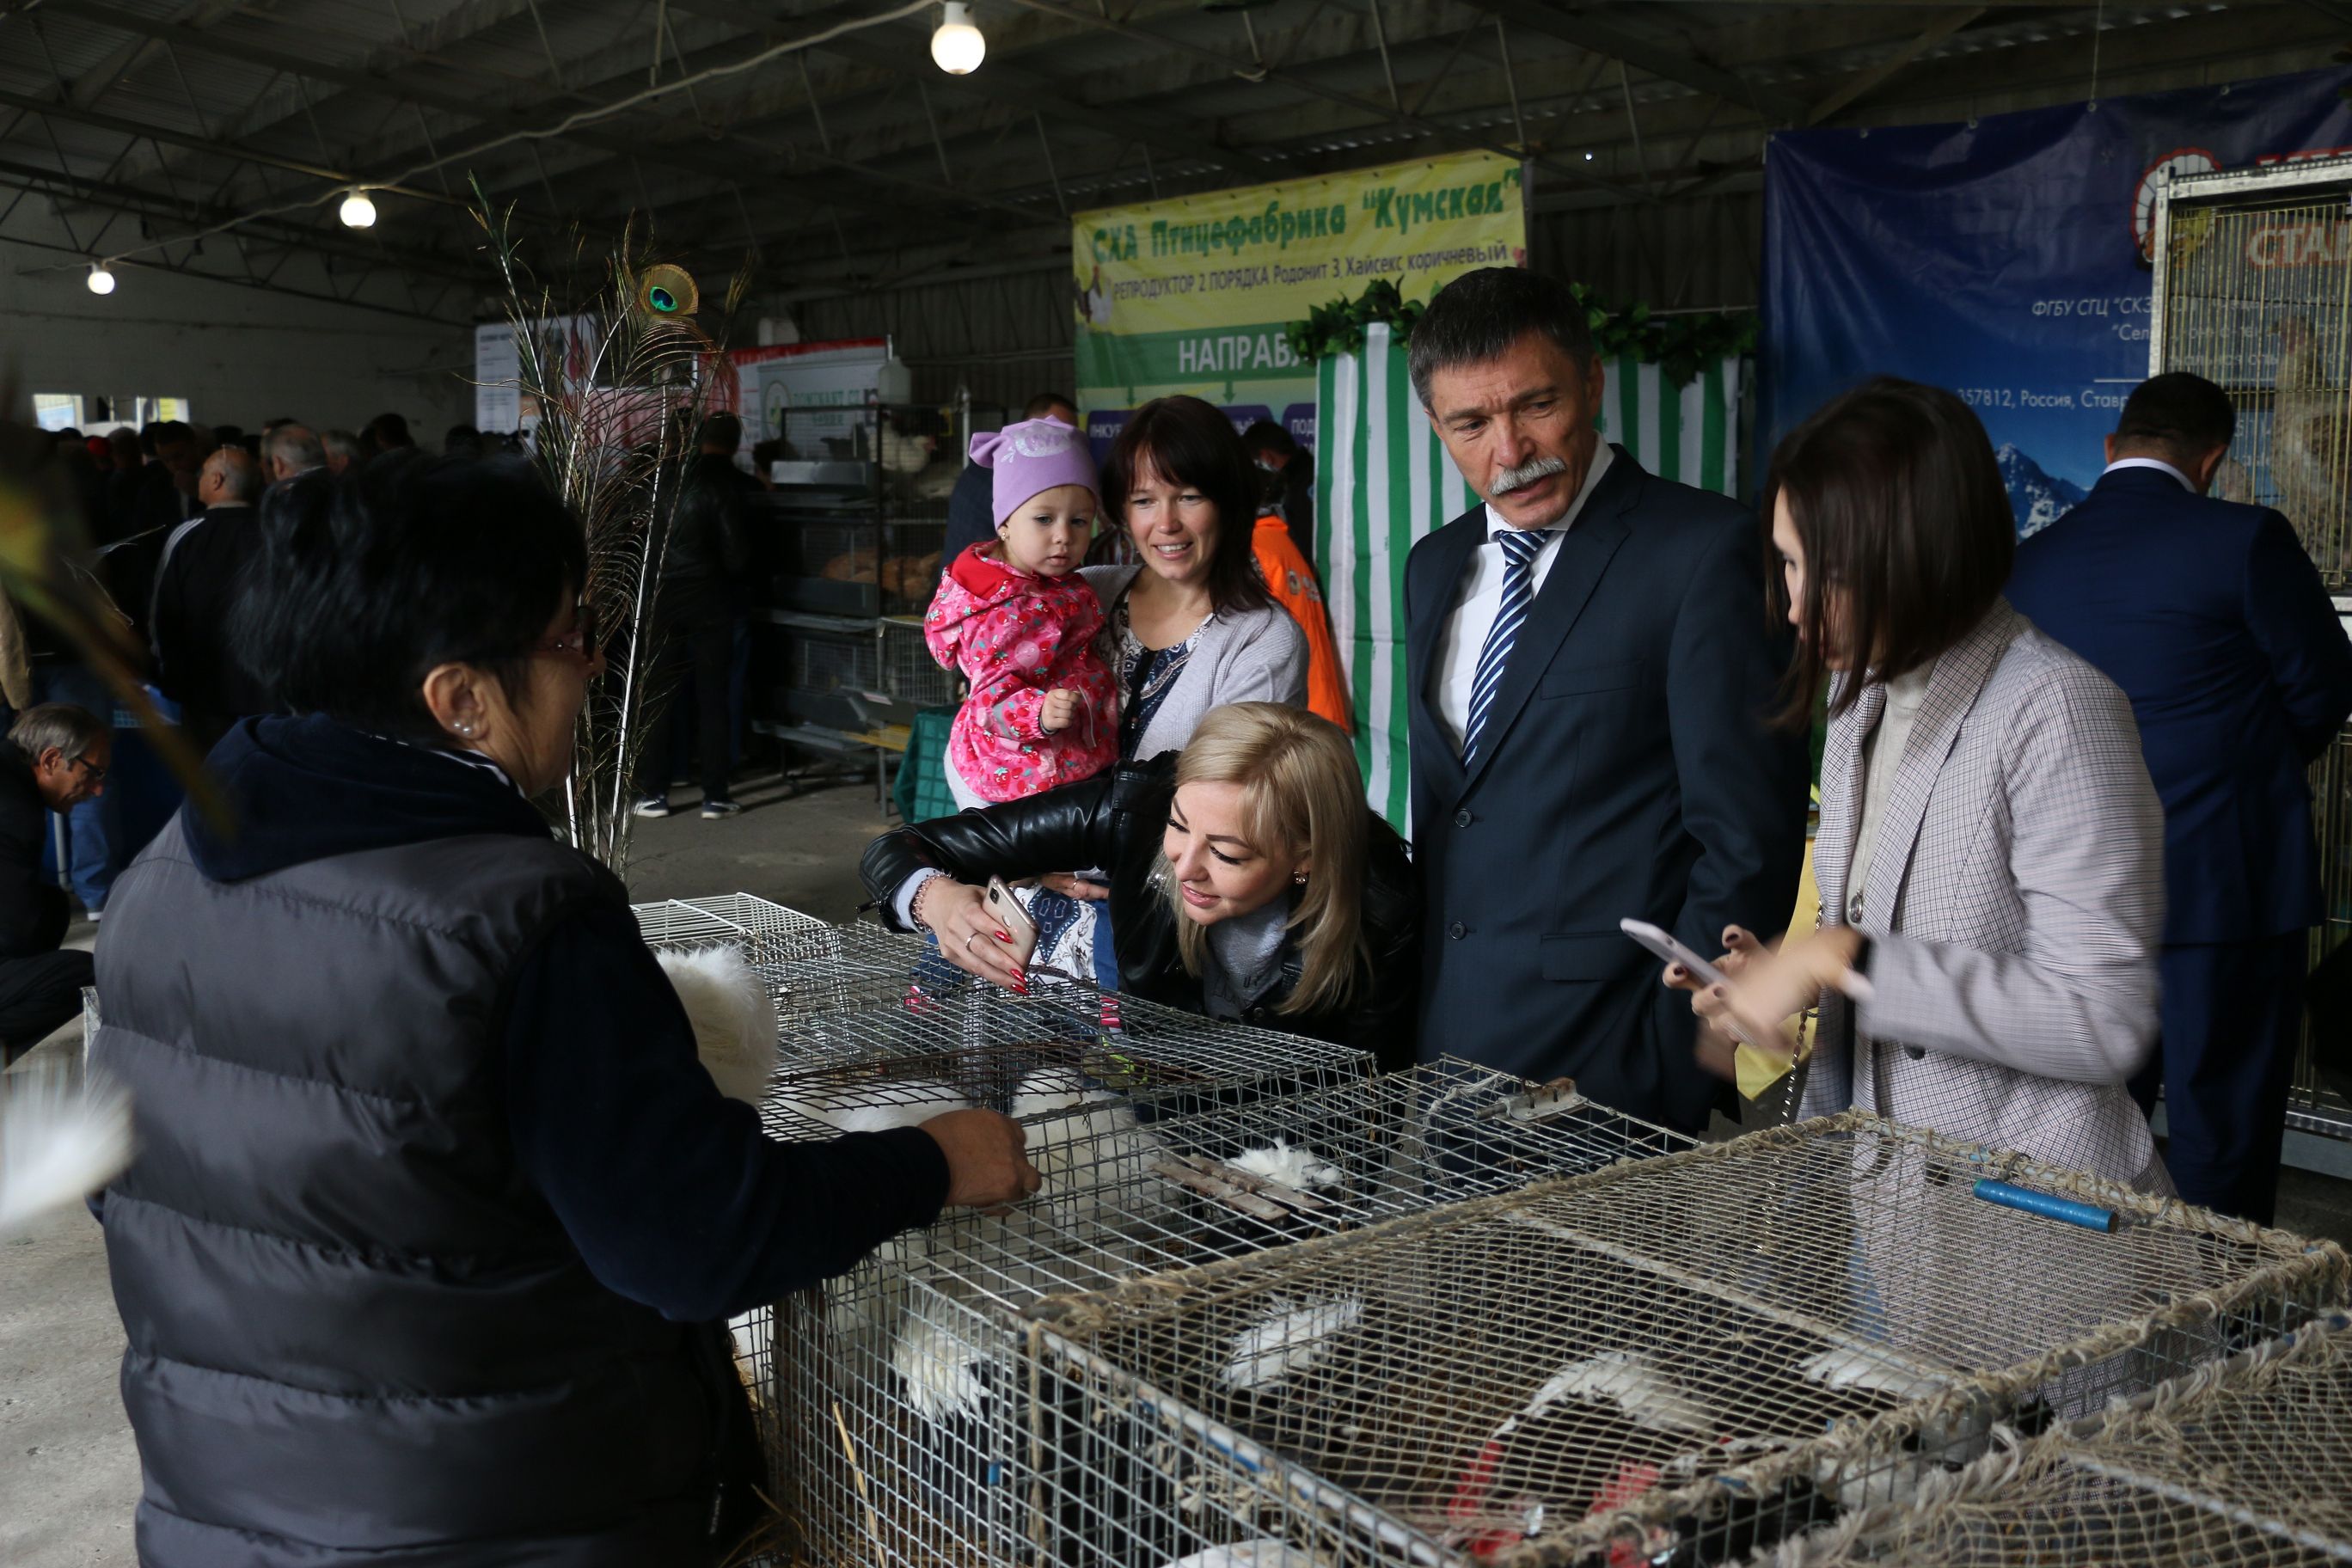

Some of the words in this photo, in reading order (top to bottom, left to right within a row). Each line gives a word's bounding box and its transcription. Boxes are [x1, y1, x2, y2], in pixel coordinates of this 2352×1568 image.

[1093, 224, 1138, 264] СХА
[1151, 200, 1346, 257] Птицефабрика
[1363, 168, 1522, 235] "Кумская"
[1113, 274, 1194, 300] РЕПРОДУКТОР
[1198, 273, 1206, 292] 2
[1210, 266, 1269, 291] ПОРЯДКА
[1273, 264, 1327, 285] Родонит
[1345, 254, 1404, 276] Хайсекс
[1407, 239, 1508, 273] коричневый
[2031, 299, 2074, 317] ФГБУ
[2076, 298, 2109, 317] СГЦ
[1179, 332, 1302, 374] НАПРАВ
[2020, 389, 2075, 410] Россия,
